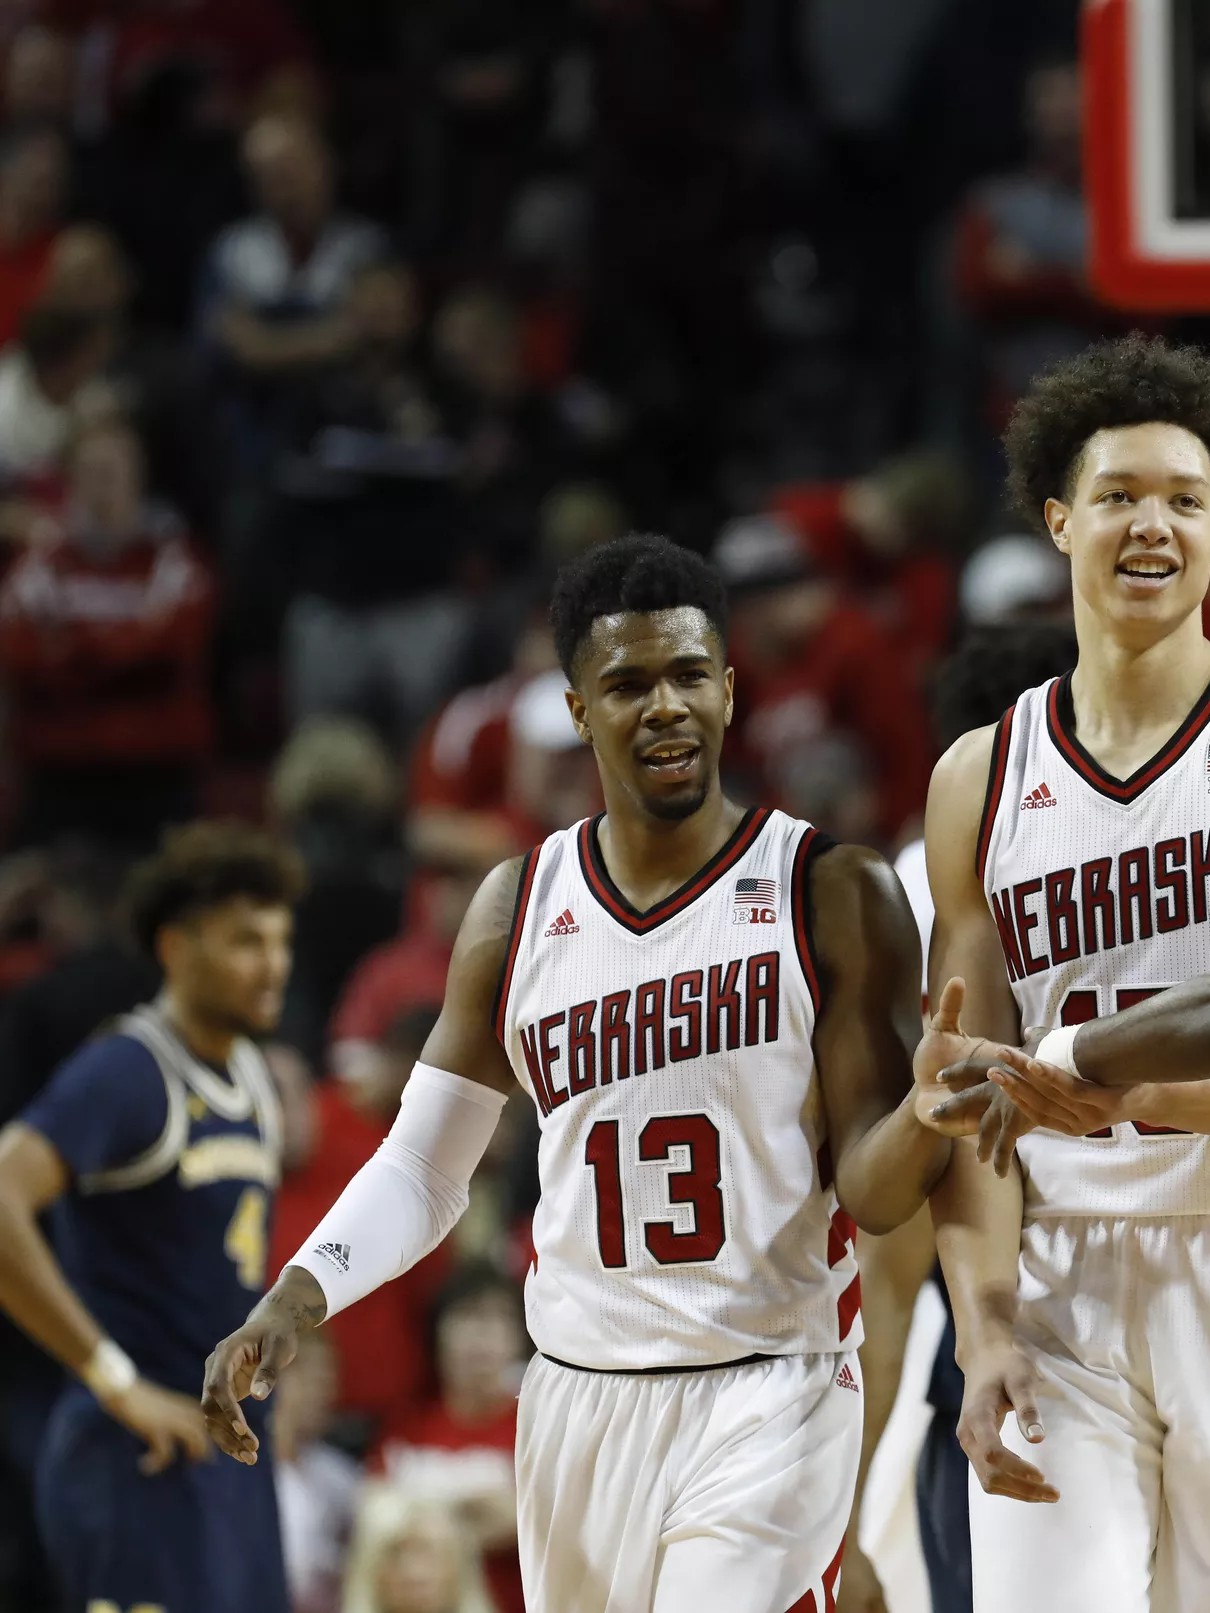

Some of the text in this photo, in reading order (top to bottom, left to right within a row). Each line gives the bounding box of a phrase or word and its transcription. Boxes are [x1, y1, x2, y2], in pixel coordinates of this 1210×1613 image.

[1020, 798, 1057, 810] adidas
[544, 925, 580, 937] adidas
[520, 950, 780, 1118] NEBRASKA
[585, 1112, 726, 1269] 13
[318, 1243, 350, 1271] adidas
